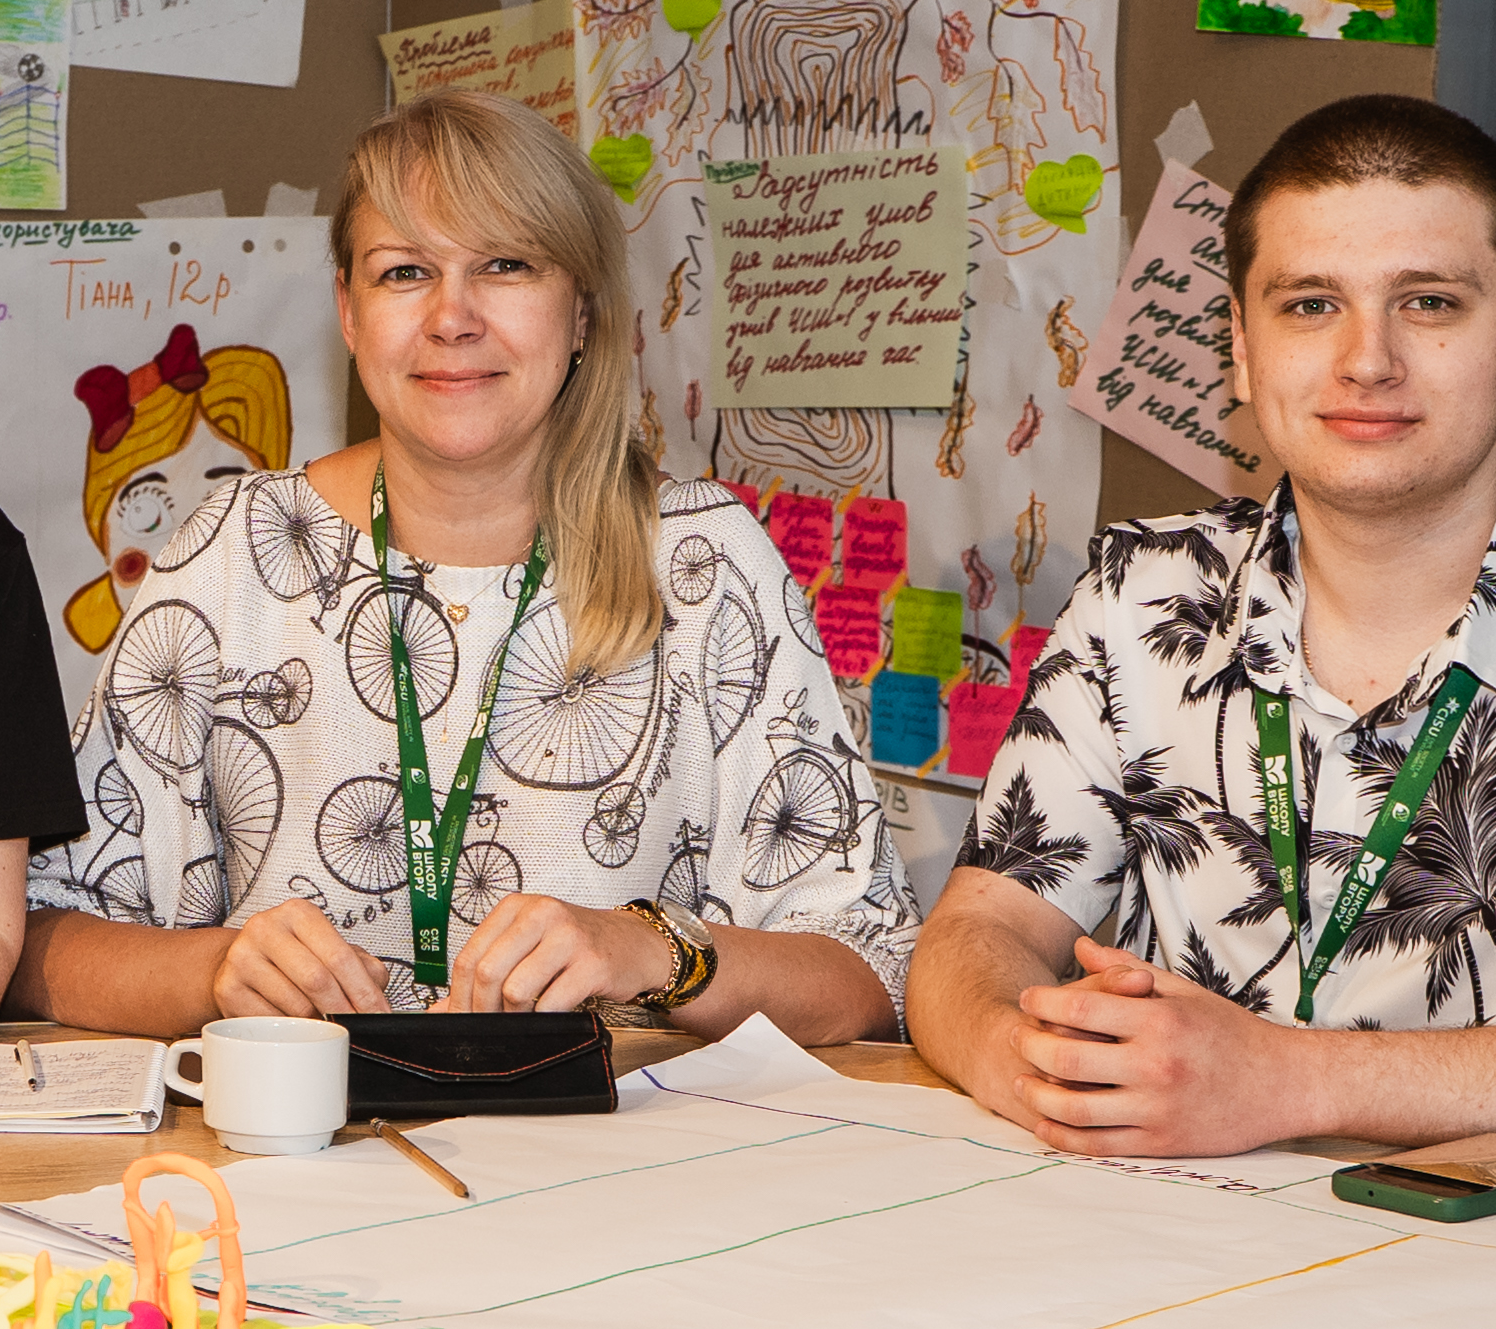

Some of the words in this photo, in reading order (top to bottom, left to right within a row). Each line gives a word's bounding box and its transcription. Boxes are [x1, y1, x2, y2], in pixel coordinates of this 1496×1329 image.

[733, 153, 939, 213] Відсутність
[721, 208, 844, 242] належних
[860, 190, 938, 245] умов
[724, 251, 762, 289] для
[773, 238, 901, 271] активного
[1132, 258, 1191, 292] для
[727, 277, 828, 316] фізичного
[833, 266, 947, 308] розвитку
[726, 306, 781, 348] учнів
[858, 309, 881, 342] у
[726, 346, 754, 393] від
[761, 339, 867, 375] навчання
[1097, 367, 1136, 411] від
[1138, 394, 1261, 473] навчання
[398, 673, 408, 702] CISU
[1428, 707, 1451, 738] CISU
[1266, 787, 1280, 833] ВГОРУ
[1279, 788, 1290, 837] ШКОЛУ
[413, 852, 424, 893] ВГОРУ
[424, 851, 437, 901] ШКОЛУ
[1334, 882, 1359, 924] ВГОРУ
[1340, 887, 1371, 934] ШКОЛУ
[420, 928, 431, 952] SOS
[430, 928, 440, 952] СХІД
